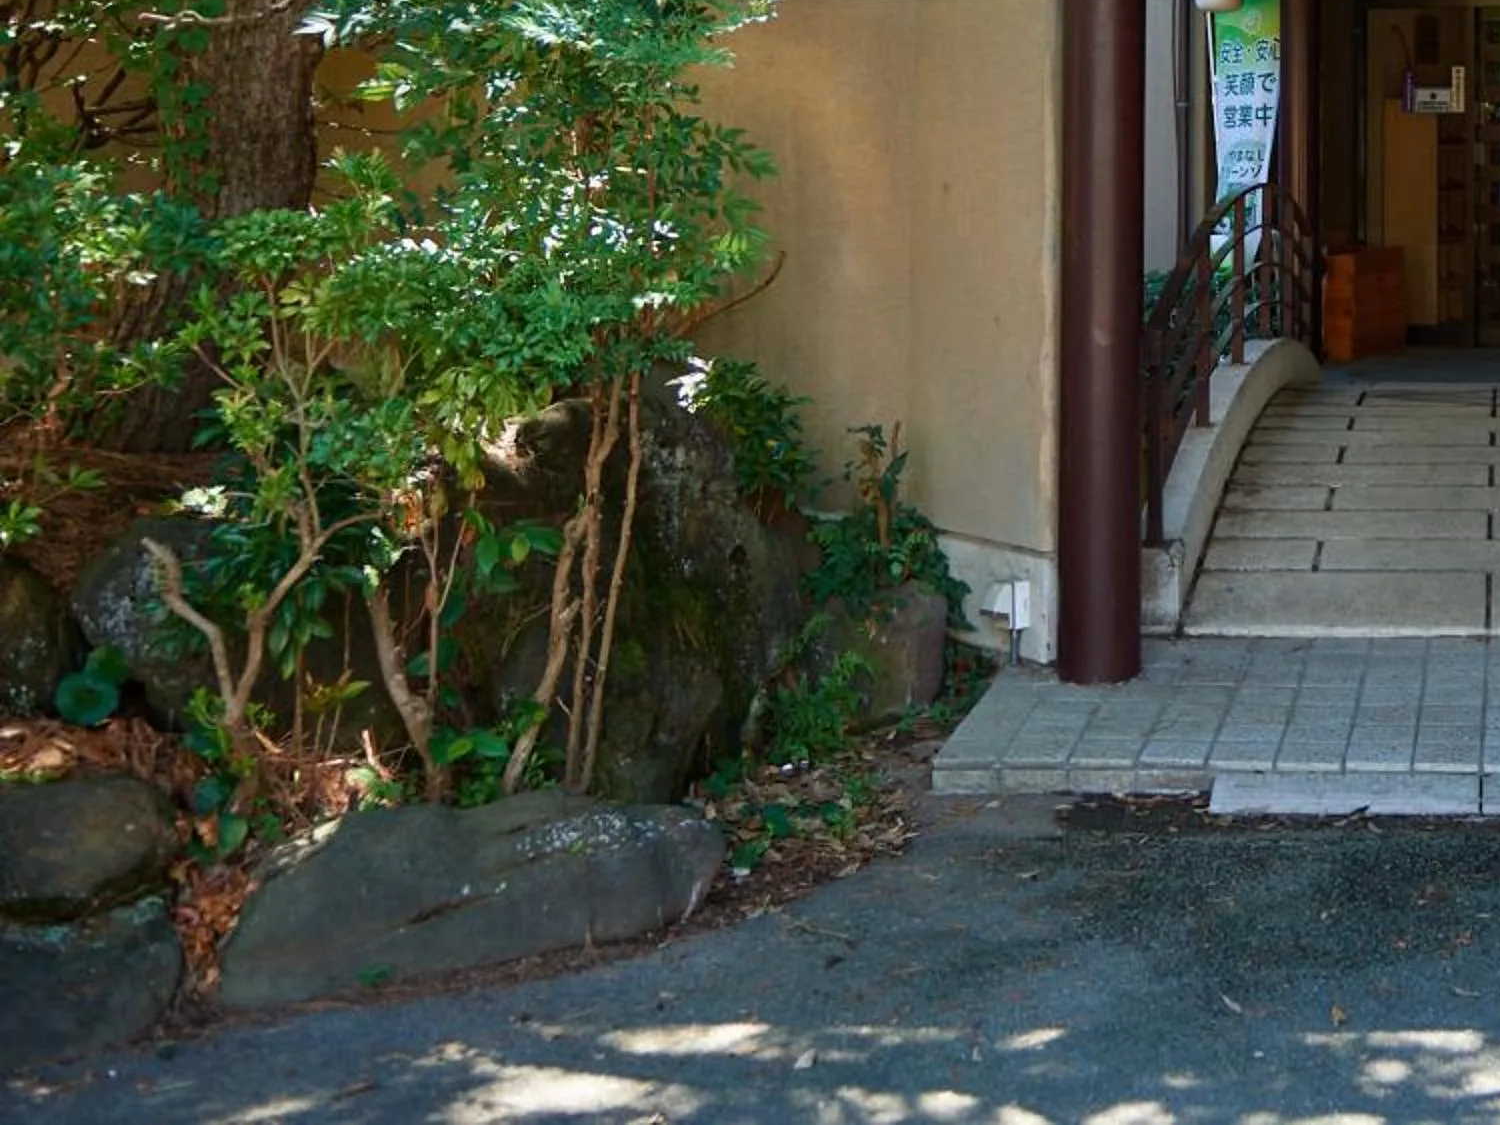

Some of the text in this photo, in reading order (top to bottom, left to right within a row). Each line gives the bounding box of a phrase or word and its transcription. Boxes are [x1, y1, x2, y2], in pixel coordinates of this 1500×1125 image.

[1224, 71, 1277, 96] 笑顔で
[1223, 102, 1274, 128] 営業中
